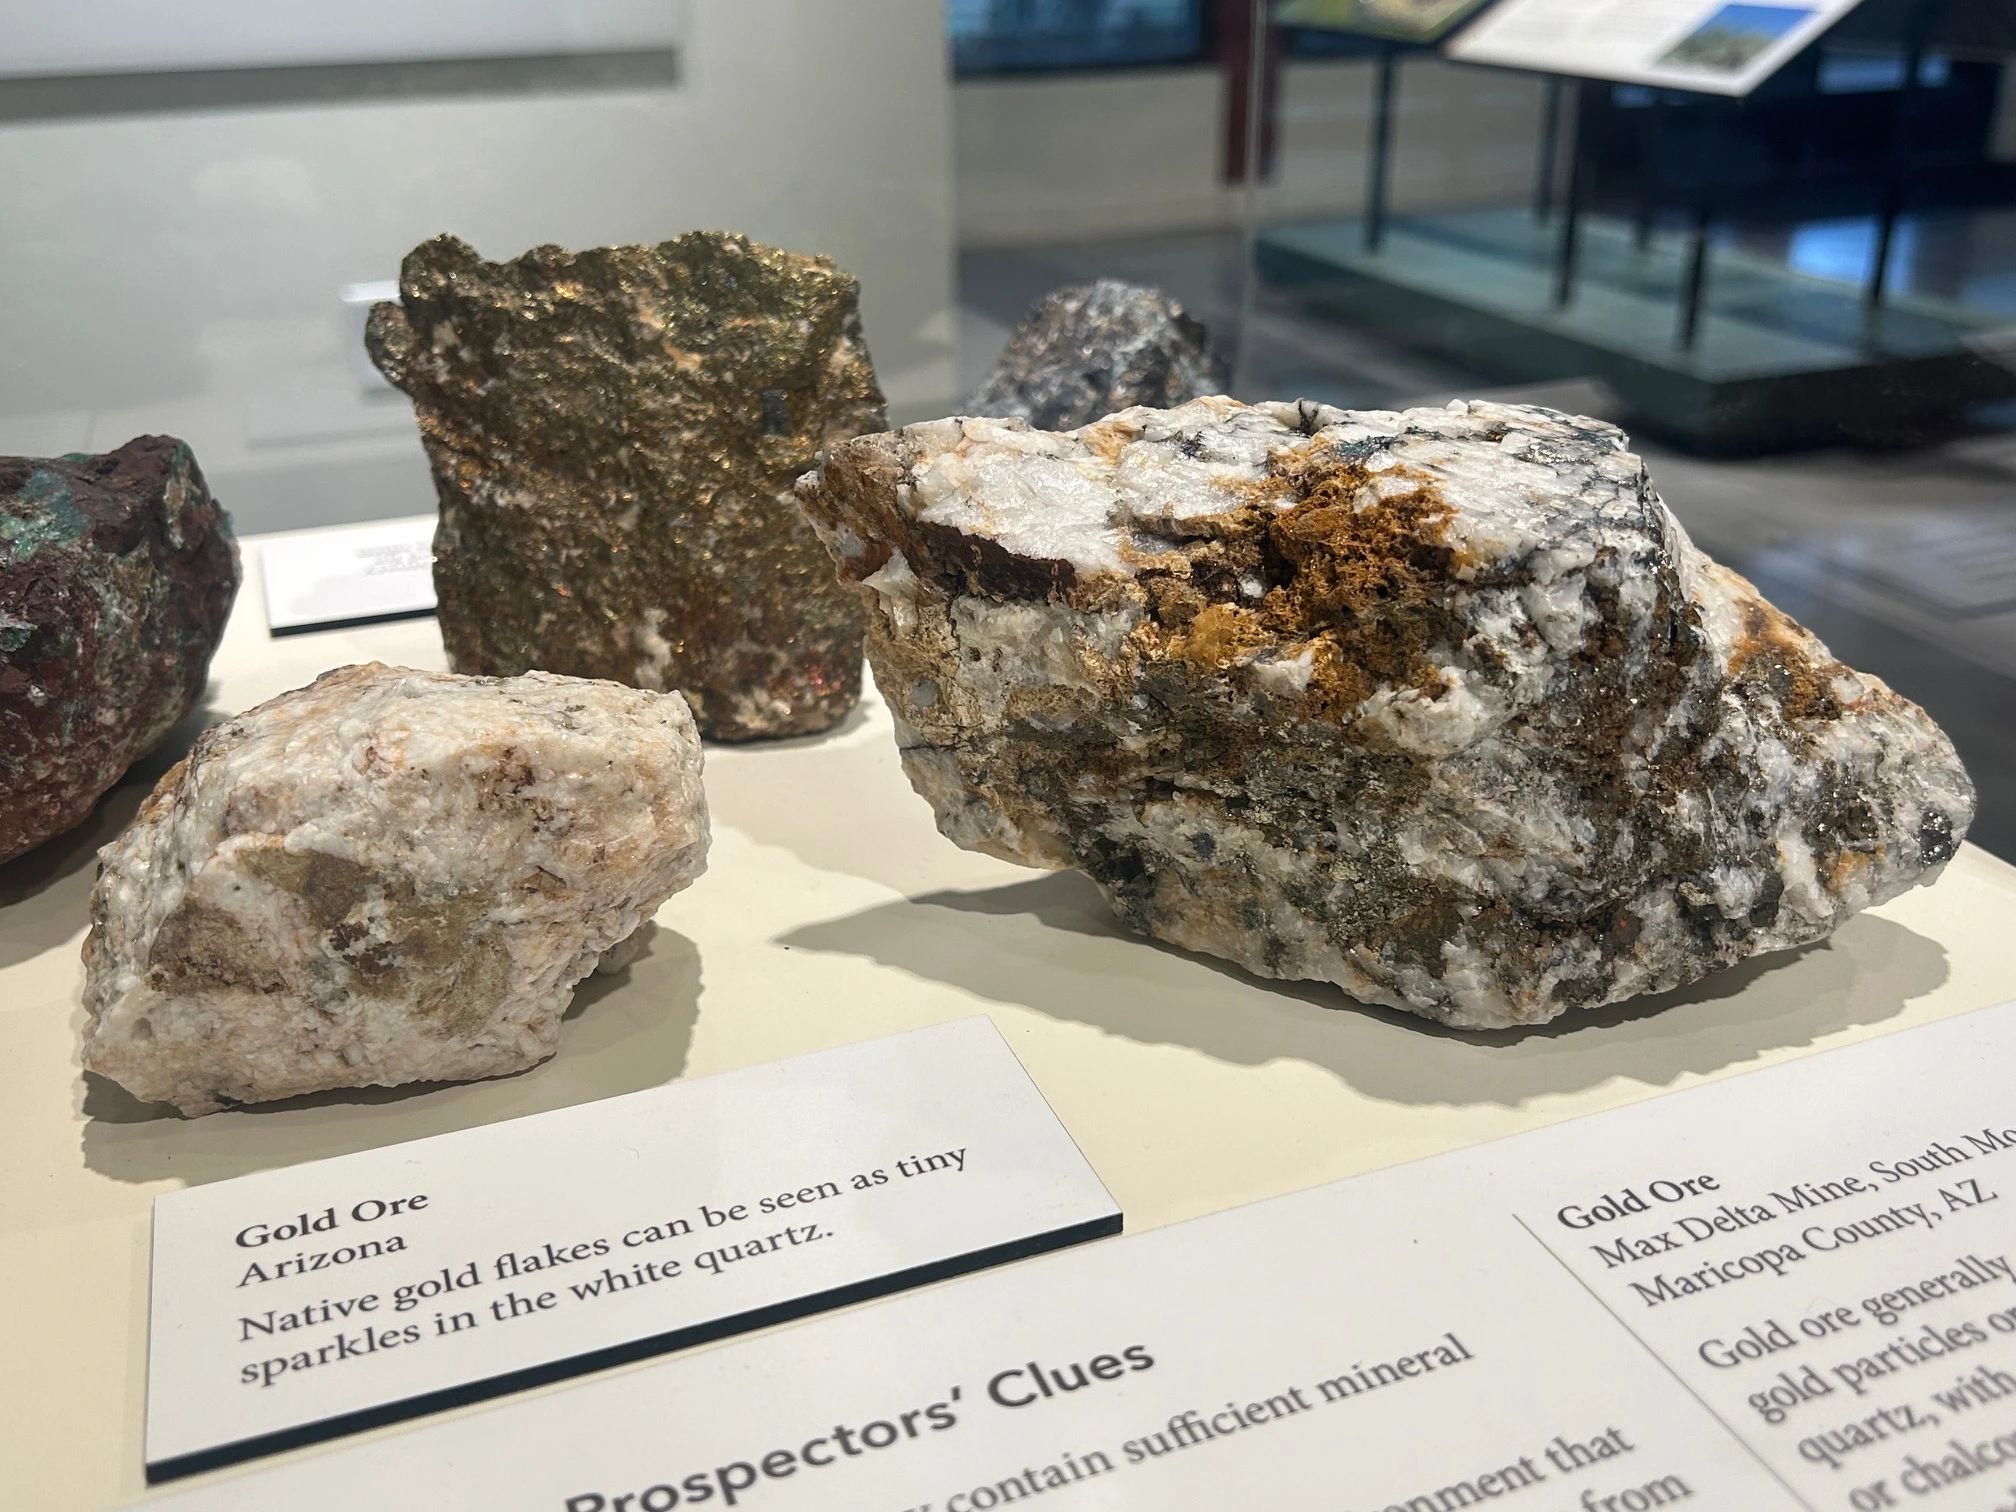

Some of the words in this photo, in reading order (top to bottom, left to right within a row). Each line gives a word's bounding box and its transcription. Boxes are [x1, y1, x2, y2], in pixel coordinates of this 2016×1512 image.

[235, 1208, 339, 1248] Gold
[351, 1195, 428, 1222] Ore
[239, 1295, 379, 1341] Native
[394, 1262, 482, 1312] gold
[494, 1239, 610, 1280] flakes
[623, 1220, 694, 1247] can
[698, 1205, 748, 1227] be
[759, 1183, 842, 1213] seen
[851, 1170, 888, 1190] as
[896, 1148, 966, 1177] tiny
[1558, 1188, 1651, 1229] Gold
[1649, 1175, 1720, 1202] Ore
[1589, 1232, 1683, 1268] Max
[1673, 1205, 1777, 1242] Delta
[1768, 1177, 1879, 1213] Mine,
[1869, 1143, 1973, 1183] South
[1628, 1245, 1806, 1307] Maricopa
[1802, 1204, 1942, 1251] County,
[1938, 1179, 1998, 1212] AZ
[237, 1236, 408, 1287] Arizona
[241, 1325, 420, 1387] sparkles
[434, 1312, 478, 1336] in
[490, 1292, 557, 1321] the
[568, 1261, 682, 1300] white
[694, 1224, 833, 1274] quartz.
[1699, 1319, 1798, 1368] Gold
[1800, 1308, 1860, 1337] ore
[1862, 1253, 2016, 1326] generally
[946, 1452, 1115, 1512] contain
[1123, 1387, 1312, 1464] sufficient
[1316, 1333, 1474, 1403] mineral
[987, 1345, 1154, 1408] Clues
[1749, 1365, 1834, 1424] gold
[1831, 1323, 1988, 1396] particles
[1798, 1406, 1940, 1469] quartz,
[1932, 1366, 2016, 1412] with
[1545, 1428, 1634, 1473] that
[1848, 1481, 1895, 1512] or
